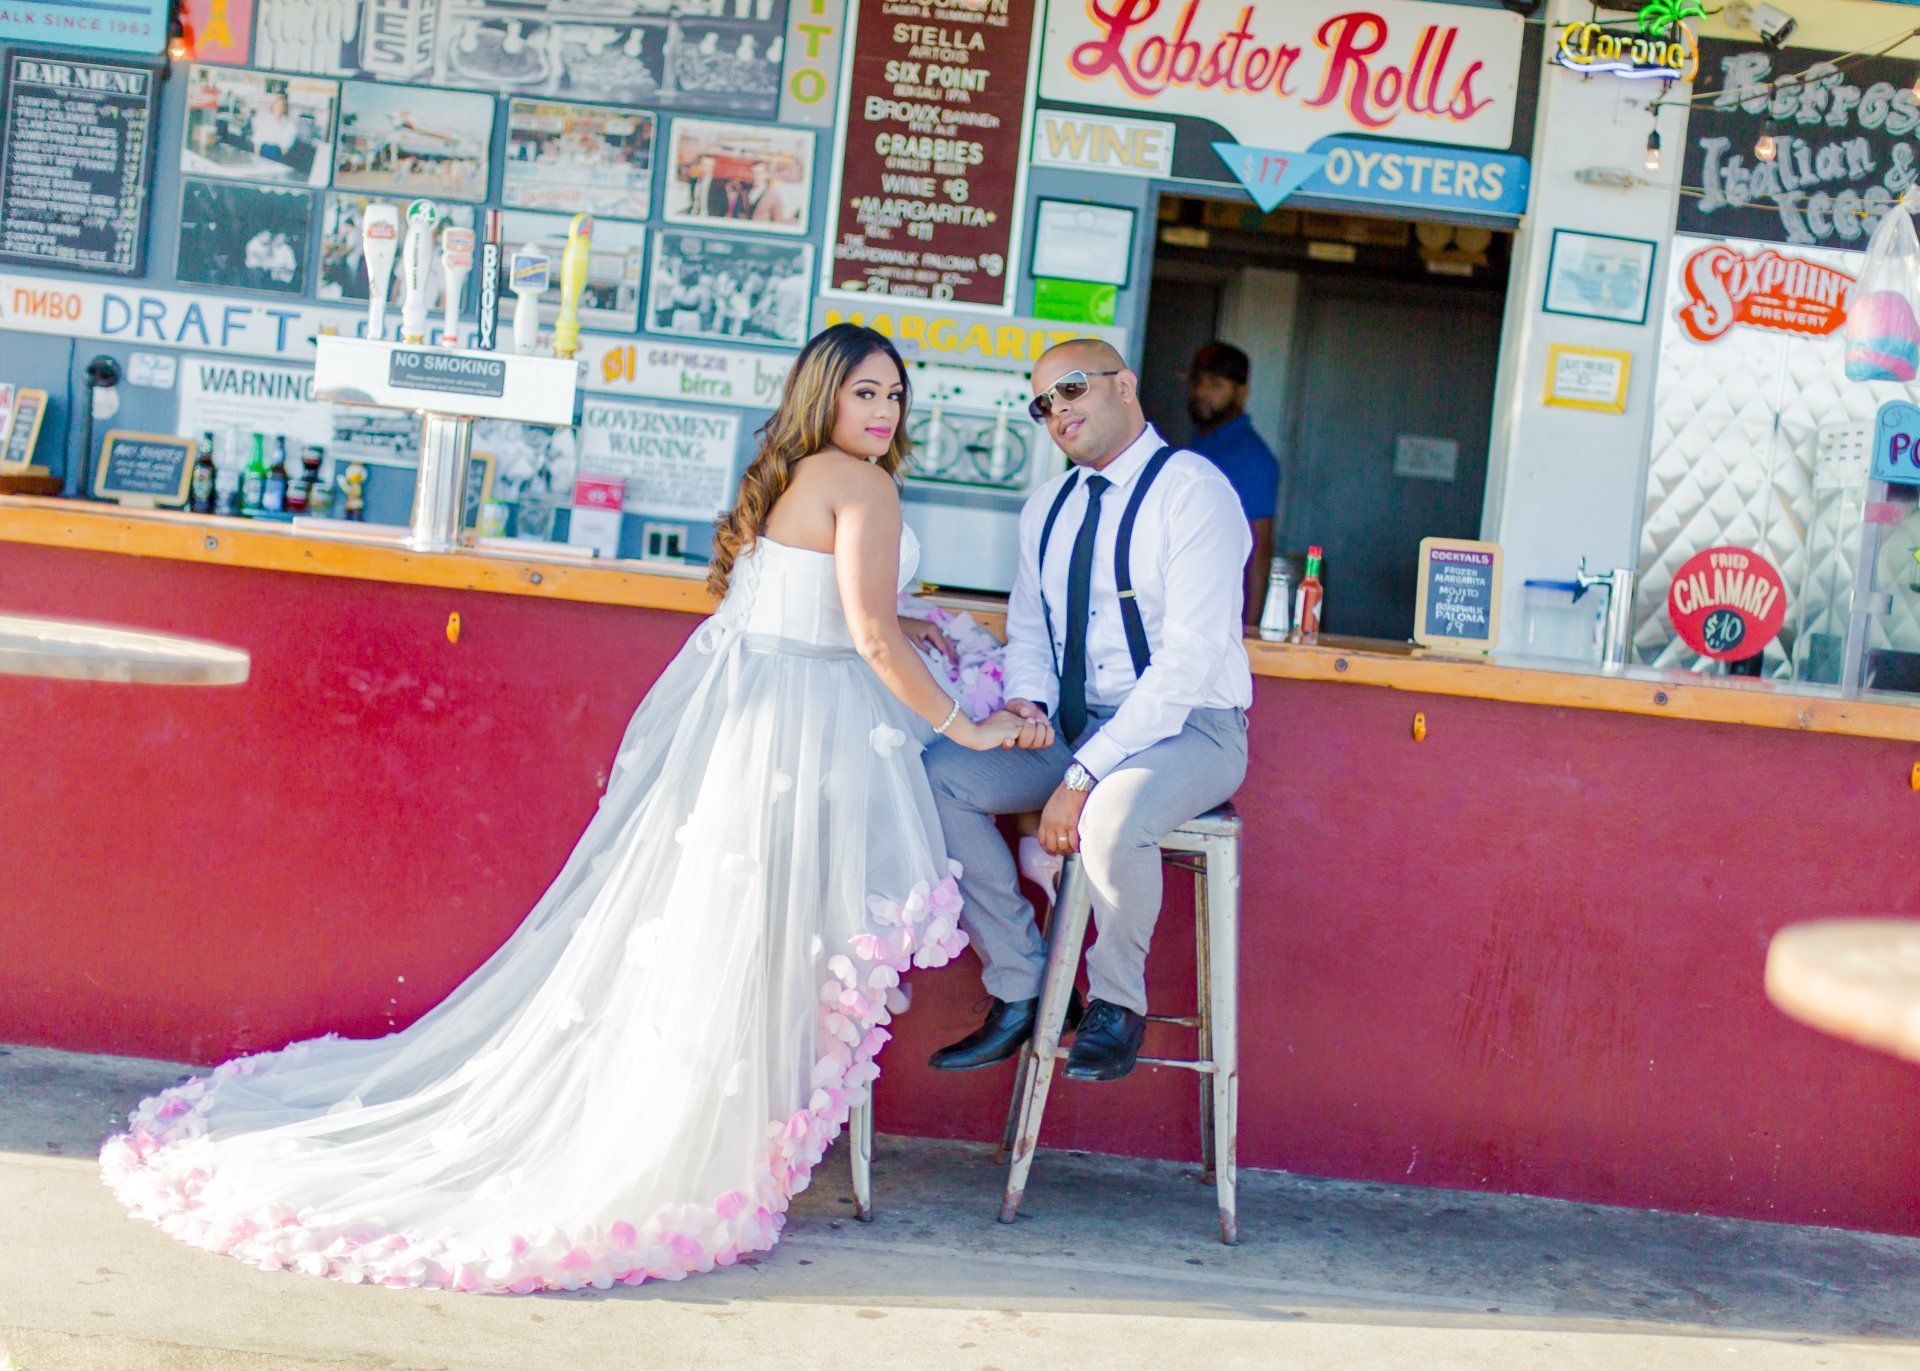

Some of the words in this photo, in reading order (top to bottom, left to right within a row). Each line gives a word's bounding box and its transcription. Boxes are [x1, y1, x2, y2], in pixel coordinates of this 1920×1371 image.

[44, 13, 100, 30] SINCE
[893, 23, 985, 51] STELLA
[1560, 21, 1685, 67] Corona
[908, 45, 970, 64] ARTOIS
[1068, 0, 1301, 97] Lobster
[1300, 11, 1495, 130] Rolls
[18, 61, 71, 87] BAR
[73, 67, 146, 94] MENU
[884, 60, 922, 84] SIX
[925, 64, 990, 92] POINT
[864, 96, 942, 125] BRONX
[875, 133, 984, 165] CRABBIES
[1044, 118, 1163, 171] WINE
[881, 173, 937, 197] WINE
[1324, 148, 1506, 200] OYSTERS
[1698, 135, 1876, 214] Italian
[1884, 142, 1918, 192] &
[480, 244, 499, 350] BRONX
[100, 293, 302, 352] DRAFT
[1751, 304, 1829, 328] BREWERY
[395, 353, 419, 368] NO
[424, 355, 501, 376] SMOKING
[648, 350, 728, 372] cerveza
[680, 370, 733, 397] birra
[588, 406, 730, 441] GOVERNMENT
[1431, 550, 1489, 564] COCKTAILS
[1444, 566, 1478, 576] FROZEN
[1710, 553, 1750, 570] FRIED
[1434, 573, 1486, 586] MARGARITA
[1438, 586, 1479, 597] MOJITO
[1672, 568, 1779, 621] CALAMARI
[1435, 609, 1485, 624] PALOMA
[1704, 614, 1743, 643] $10
